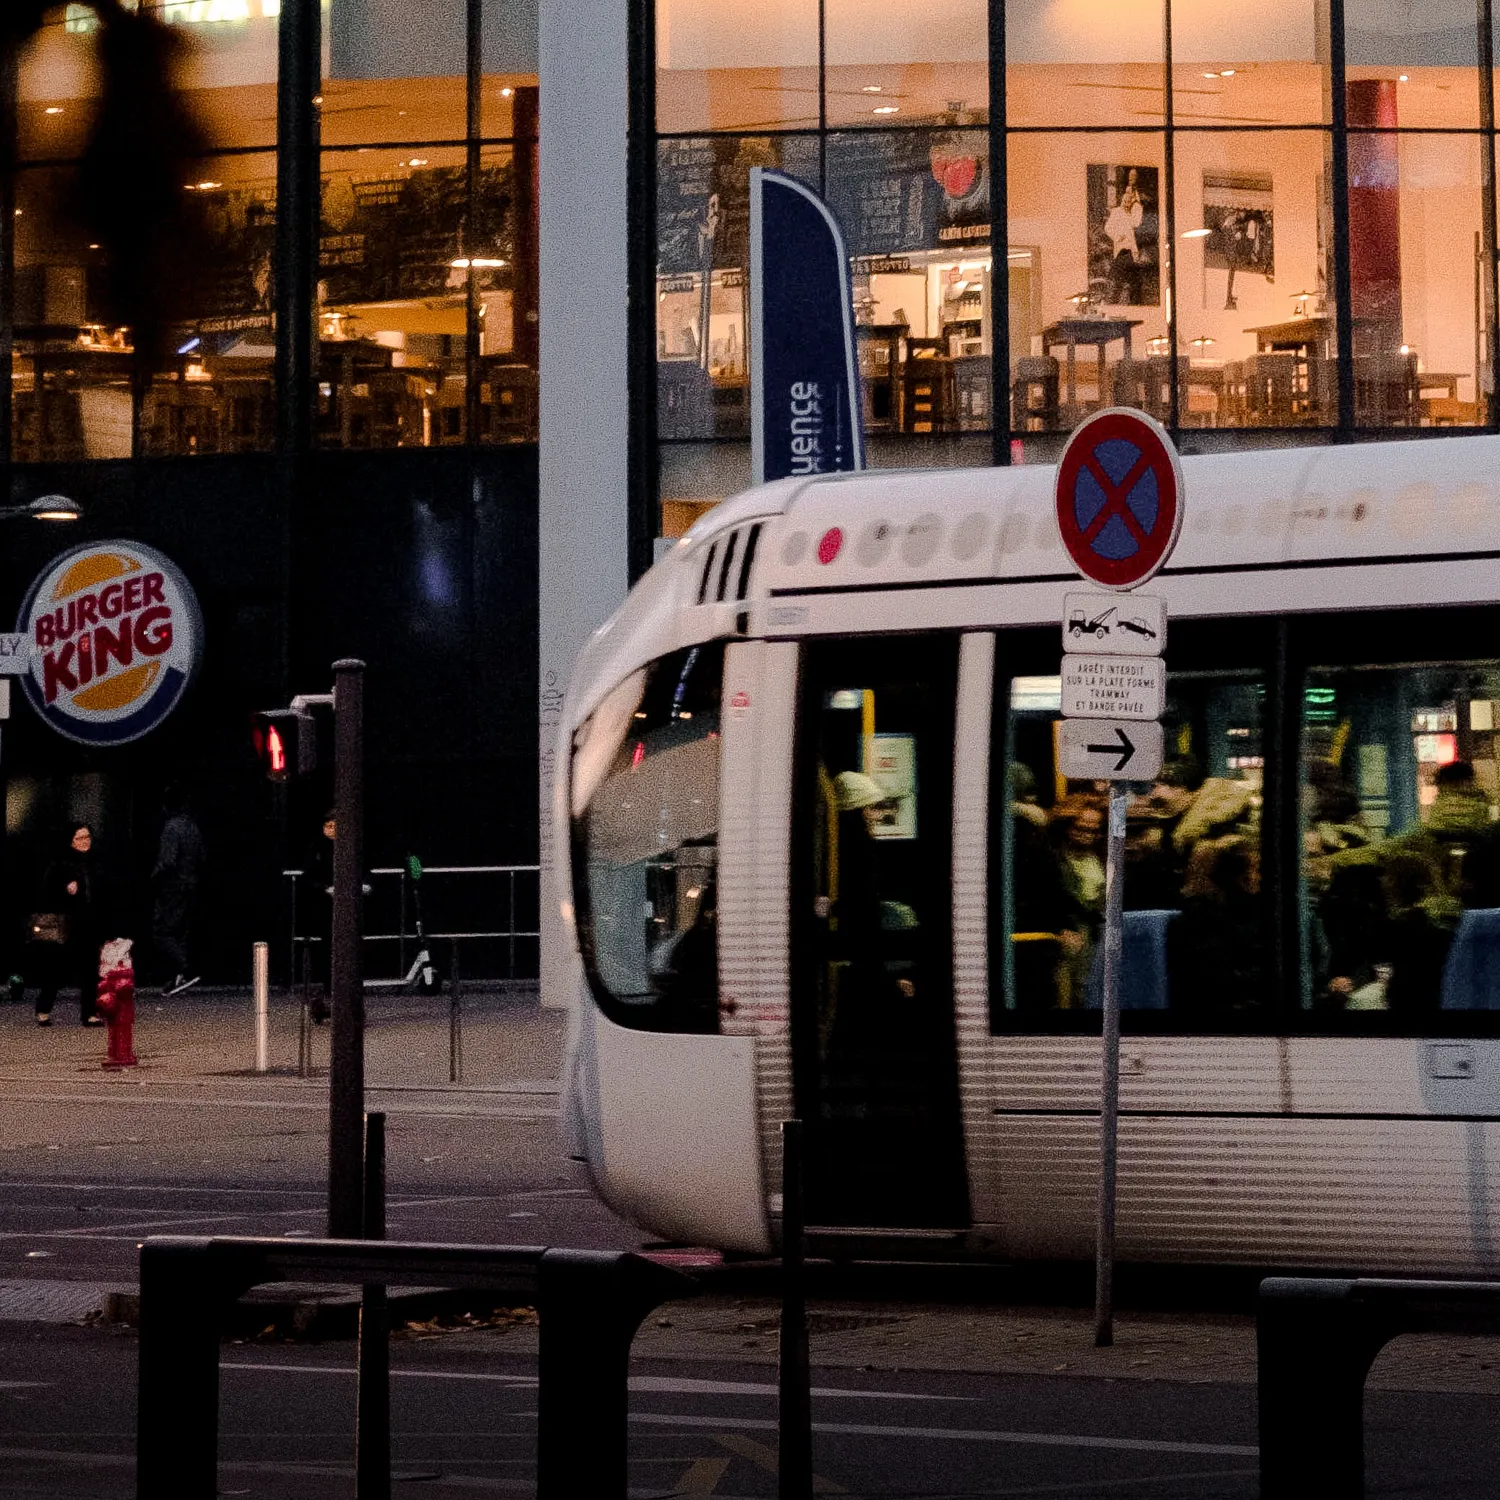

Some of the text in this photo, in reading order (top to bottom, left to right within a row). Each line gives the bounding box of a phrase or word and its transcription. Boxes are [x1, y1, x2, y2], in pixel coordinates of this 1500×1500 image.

[35, 572, 166, 648] BURGER
[42, 605, 174, 706] KING
[1107, 665, 1144, 676] INTERDIT
[1066, 676, 1156, 689] SUR LA PLATE FORME
[1091, 689, 1130, 698] TRAMWAY
[1075, 700, 1086, 711] ET
[1088, 700, 1115, 712] BANDE
